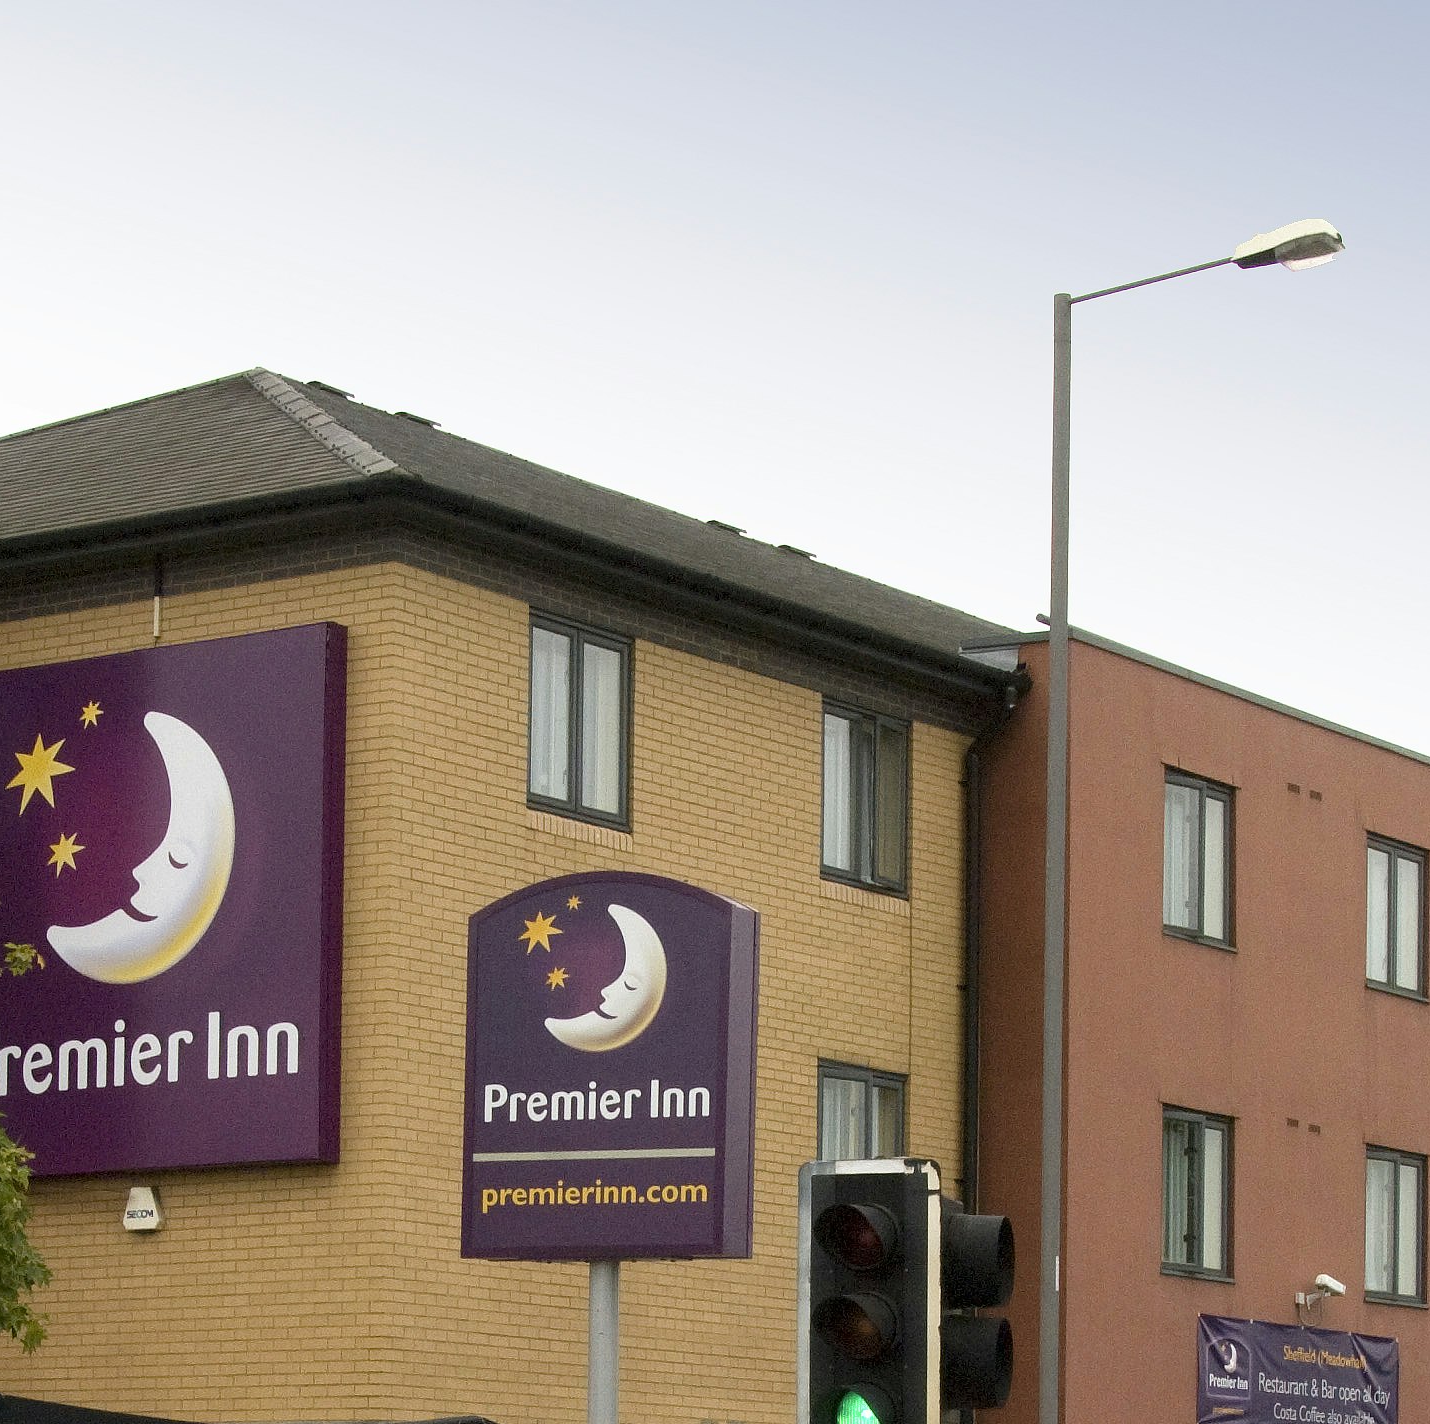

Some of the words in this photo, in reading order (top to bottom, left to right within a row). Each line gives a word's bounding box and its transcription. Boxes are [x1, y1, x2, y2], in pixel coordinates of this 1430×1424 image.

[207, 1011, 299, 1080] Inn
[484, 1081, 642, 1123] Premier
[650, 1079, 710, 1119] Inn
[482, 1179, 709, 1214] premierinn.com
[1209, 1373, 1237, 1389] Premier
[1237, 1376, 1249, 1390] Inn
[1258, 1371, 1309, 1397] Restaurant
[1311, 1378, 1319, 1399] &
[1321, 1379, 1336, 1399] Bar
[1339, 1387, 1361, 1406] open
[1362, 1385, 1372, 1404] all
[1374, 1386, 1391, 1411] day
[1273, 1402, 1297, 1421] Costa
[1299, 1404, 1326, 1424] Coffee
[1327, 1408, 1343, 1424] also
